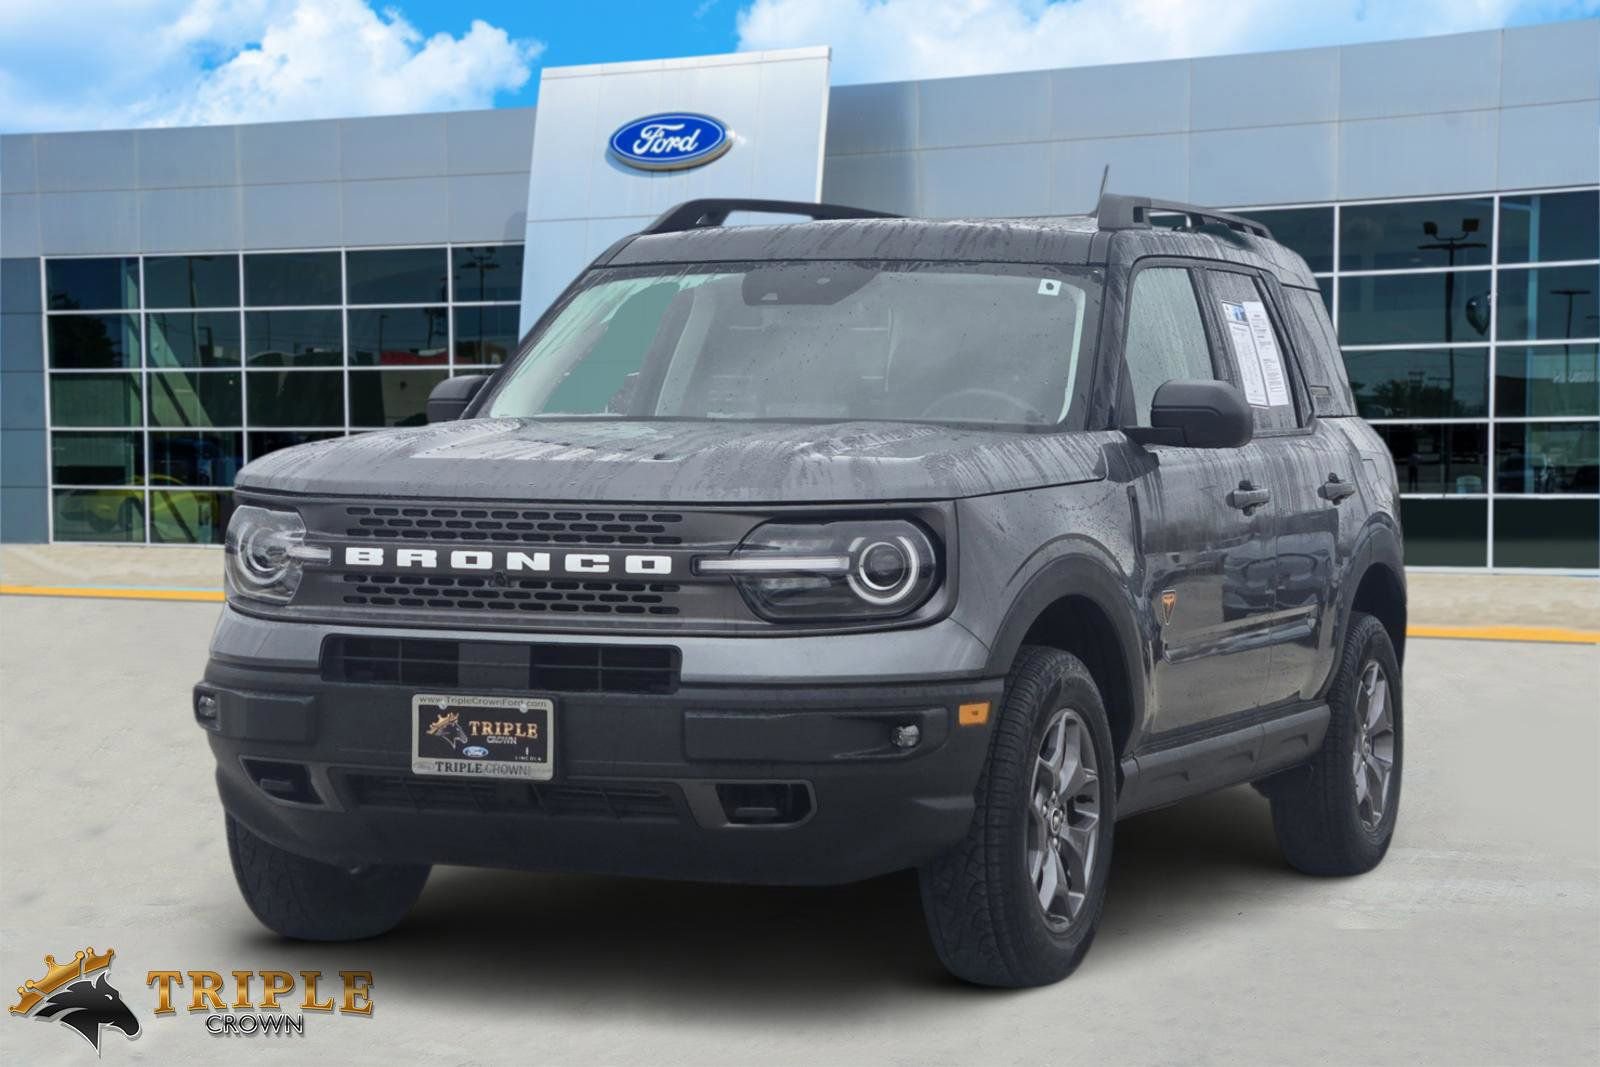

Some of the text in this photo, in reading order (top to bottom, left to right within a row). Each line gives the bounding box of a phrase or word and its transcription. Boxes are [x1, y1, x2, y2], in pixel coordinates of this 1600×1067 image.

[633, 123, 701, 155] Ford
[345, 547, 672, 575] BRONCO
[469, 720, 538, 739] TRIPLE
[486, 735, 518, 745] CROWN
